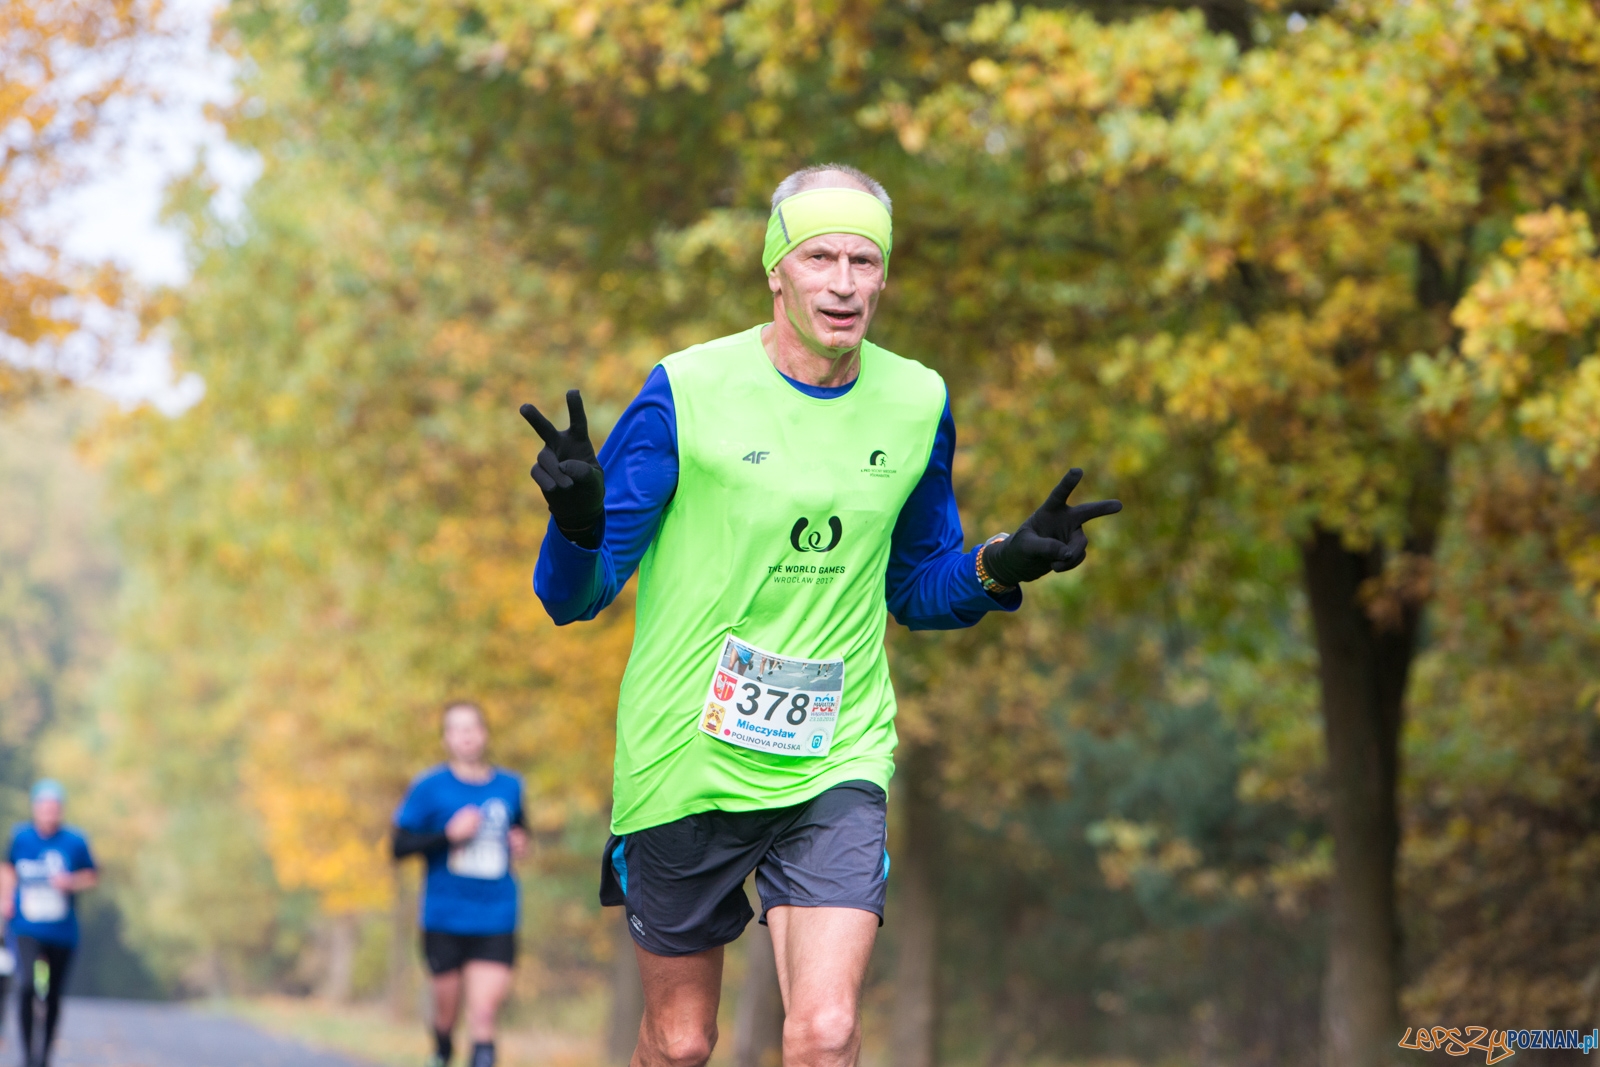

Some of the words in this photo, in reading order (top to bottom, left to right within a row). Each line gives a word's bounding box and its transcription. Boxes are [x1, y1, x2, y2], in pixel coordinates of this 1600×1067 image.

[742, 451, 770, 464] 4F
[768, 565, 783, 574] THE
[785, 565, 816, 574] WORLD
[818, 566, 846, 574] GAMES
[816, 577, 834, 585] 2017
[736, 682, 810, 726] 378
[736, 718, 797, 739] Mieczysław
[731, 731, 771, 747] POLINOVA
[772, 741, 801, 751] POLSKA
